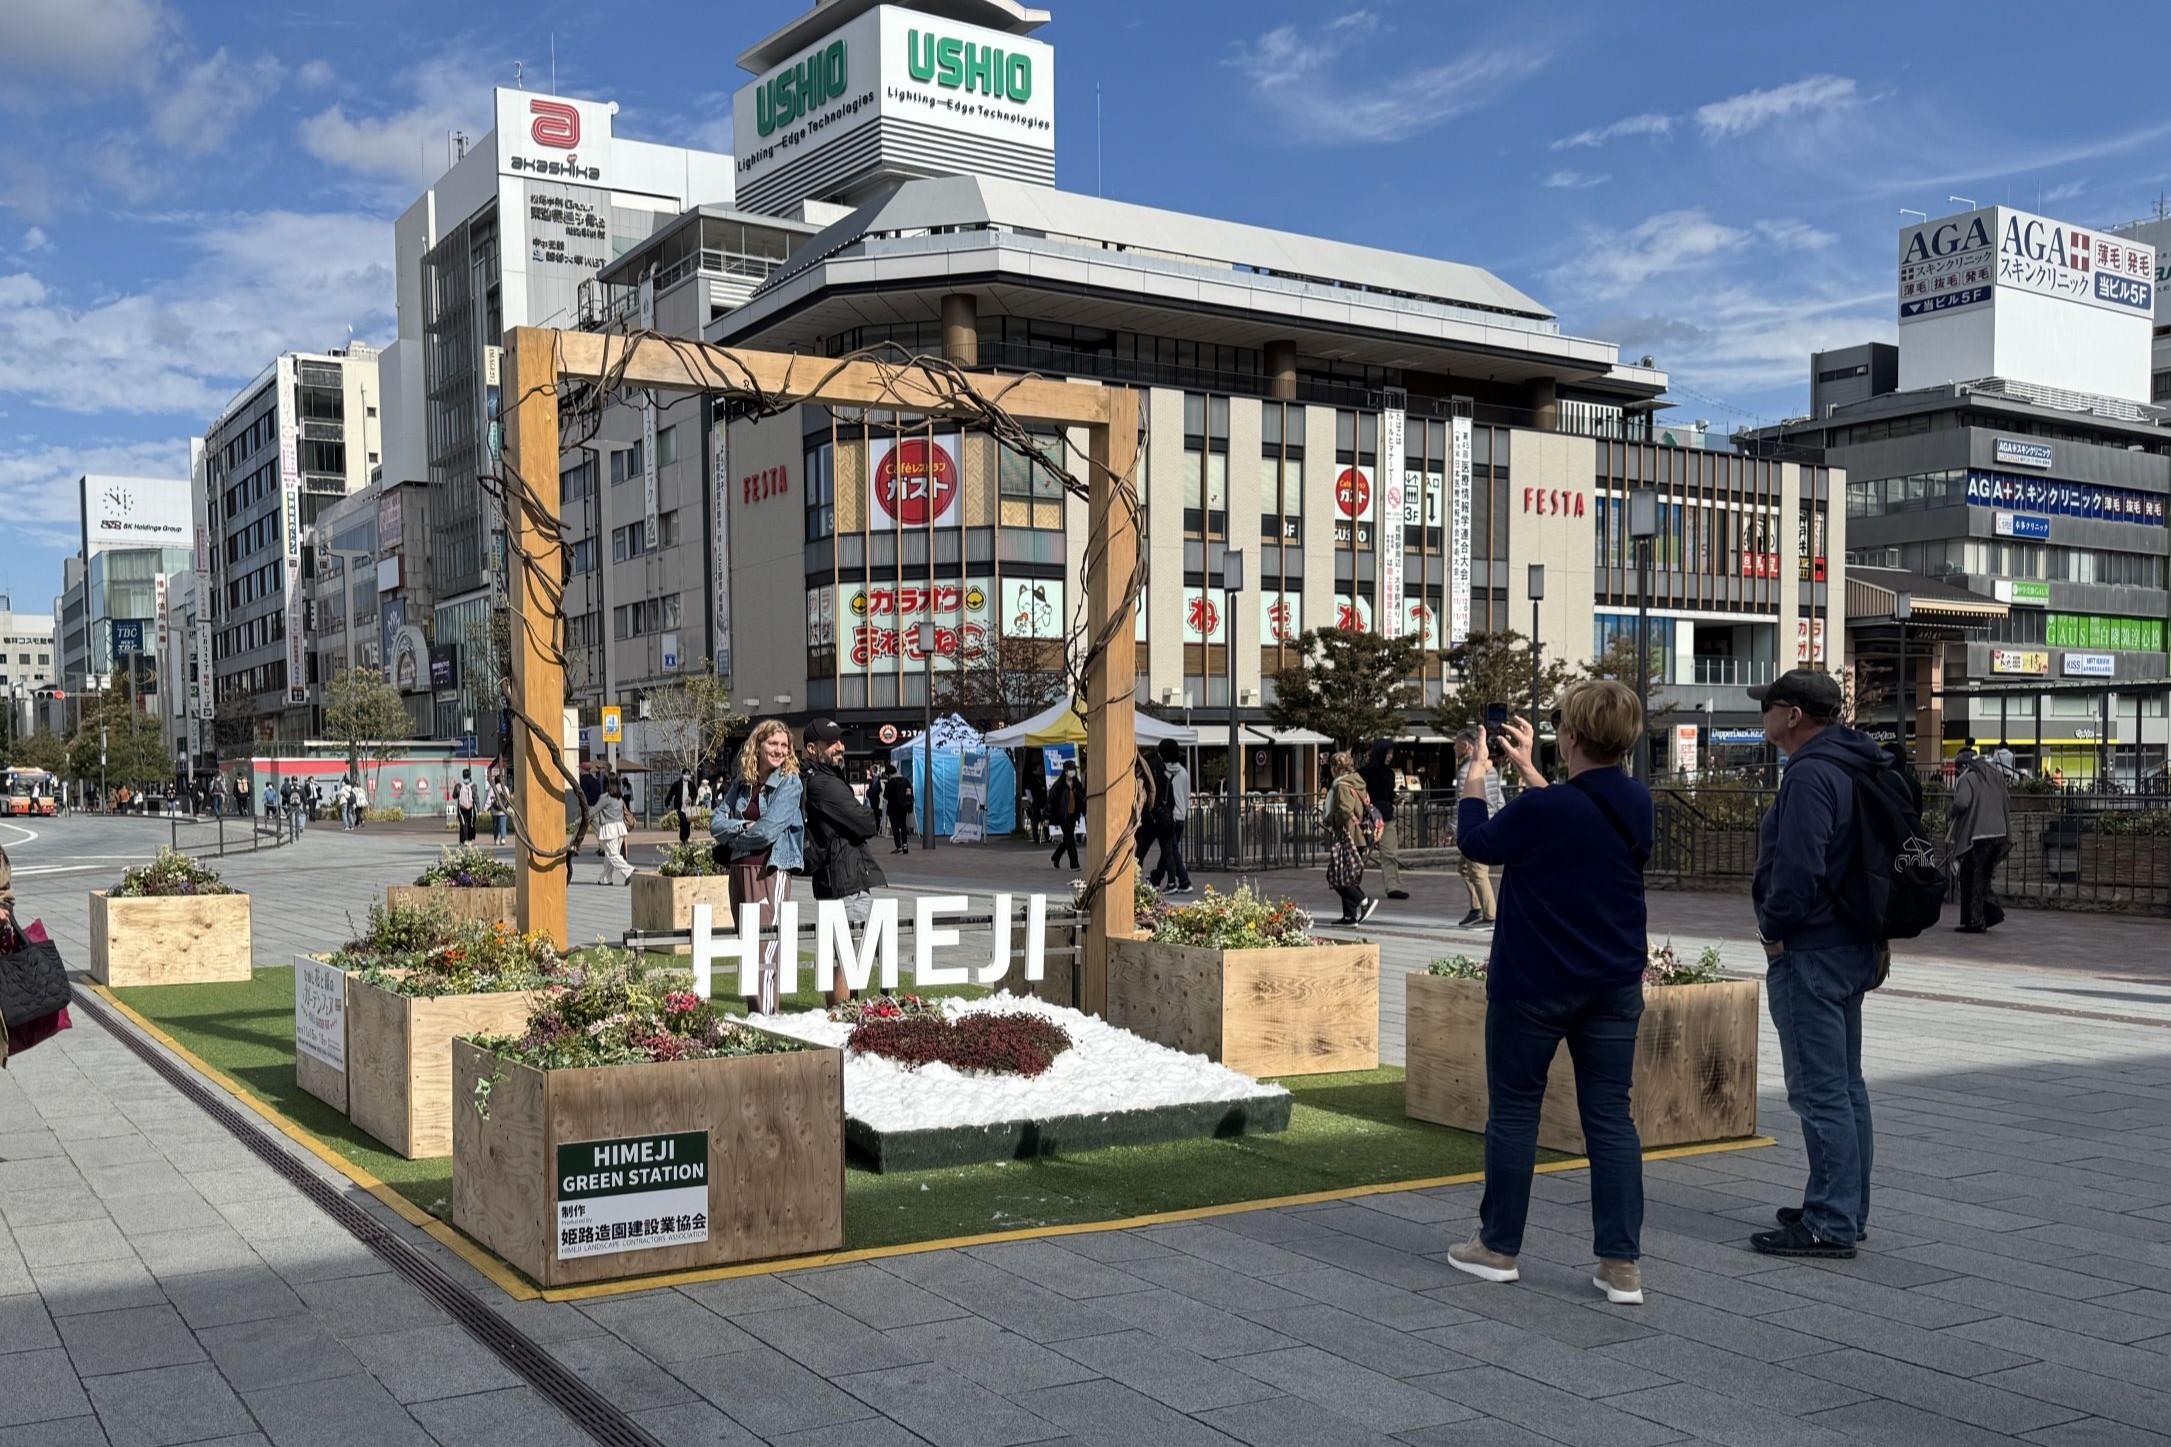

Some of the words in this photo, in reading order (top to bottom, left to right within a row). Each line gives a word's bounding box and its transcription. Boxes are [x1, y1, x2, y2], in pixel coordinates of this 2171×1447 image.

[908, 28, 1032, 104] USHIO
[756, 39, 848, 137] USHIO
[808, 91, 875, 135] Technologies
[978, 104, 1050, 131] Technologies
[511, 154, 600, 181] akashika
[1903, 215, 1991, 263] AGA
[2001, 215, 2068, 268] AGA
[1917, 251, 1991, 276] スキンクリニック
[2097, 242, 2121, 264] 薄毛
[2127, 251, 2150, 277] 発毛
[1934, 275, 1958, 290] 抜毛
[1965, 268, 1990, 283] 発毛
[2001, 257, 2088, 296] スキンクリニック
[1903, 283, 1928, 296] 薄毛
[1923, 289, 1982, 312] 当ビル5F
[2099, 277, 2148, 305] 当ビル5F
[743, 465, 788, 505] FESTA
[886, 476, 949, 501] ガスト
[1404, 506, 1419, 523] 3F
[1523, 487, 1585, 518] FESTA
[2146, 501, 2162, 517] 発毛
[162, 525, 182, 533] Group
[867, 584, 966, 616] カラオケ
[1187, 596, 1220, 635] ね
[117, 627, 138, 639] TBC
[851, 620, 987, 667] まねきねこ
[2047, 625, 2087, 646] GAUS
[2066, 660, 2081, 670] KISS
[691, 893, 1047, 999] HIMEJI
[594, 1140, 675, 1167] HIMEJI
[563, 1171, 623, 1192] GREEN
[629, 1162, 704, 1185] STATION
[561, 1204, 586, 1219] 制作
[561, 1218, 585, 1226] Produced
[561, 1213, 706, 1246] 姫路造園建設業協会
[561, 1246, 582, 1255] HIMEJI
[584, 1241, 620, 1252] LANDSCAPE
[622, 1236, 666, 1246] CONTRACTORS
[668, 1231, 707, 1241] ASSOCIATION
